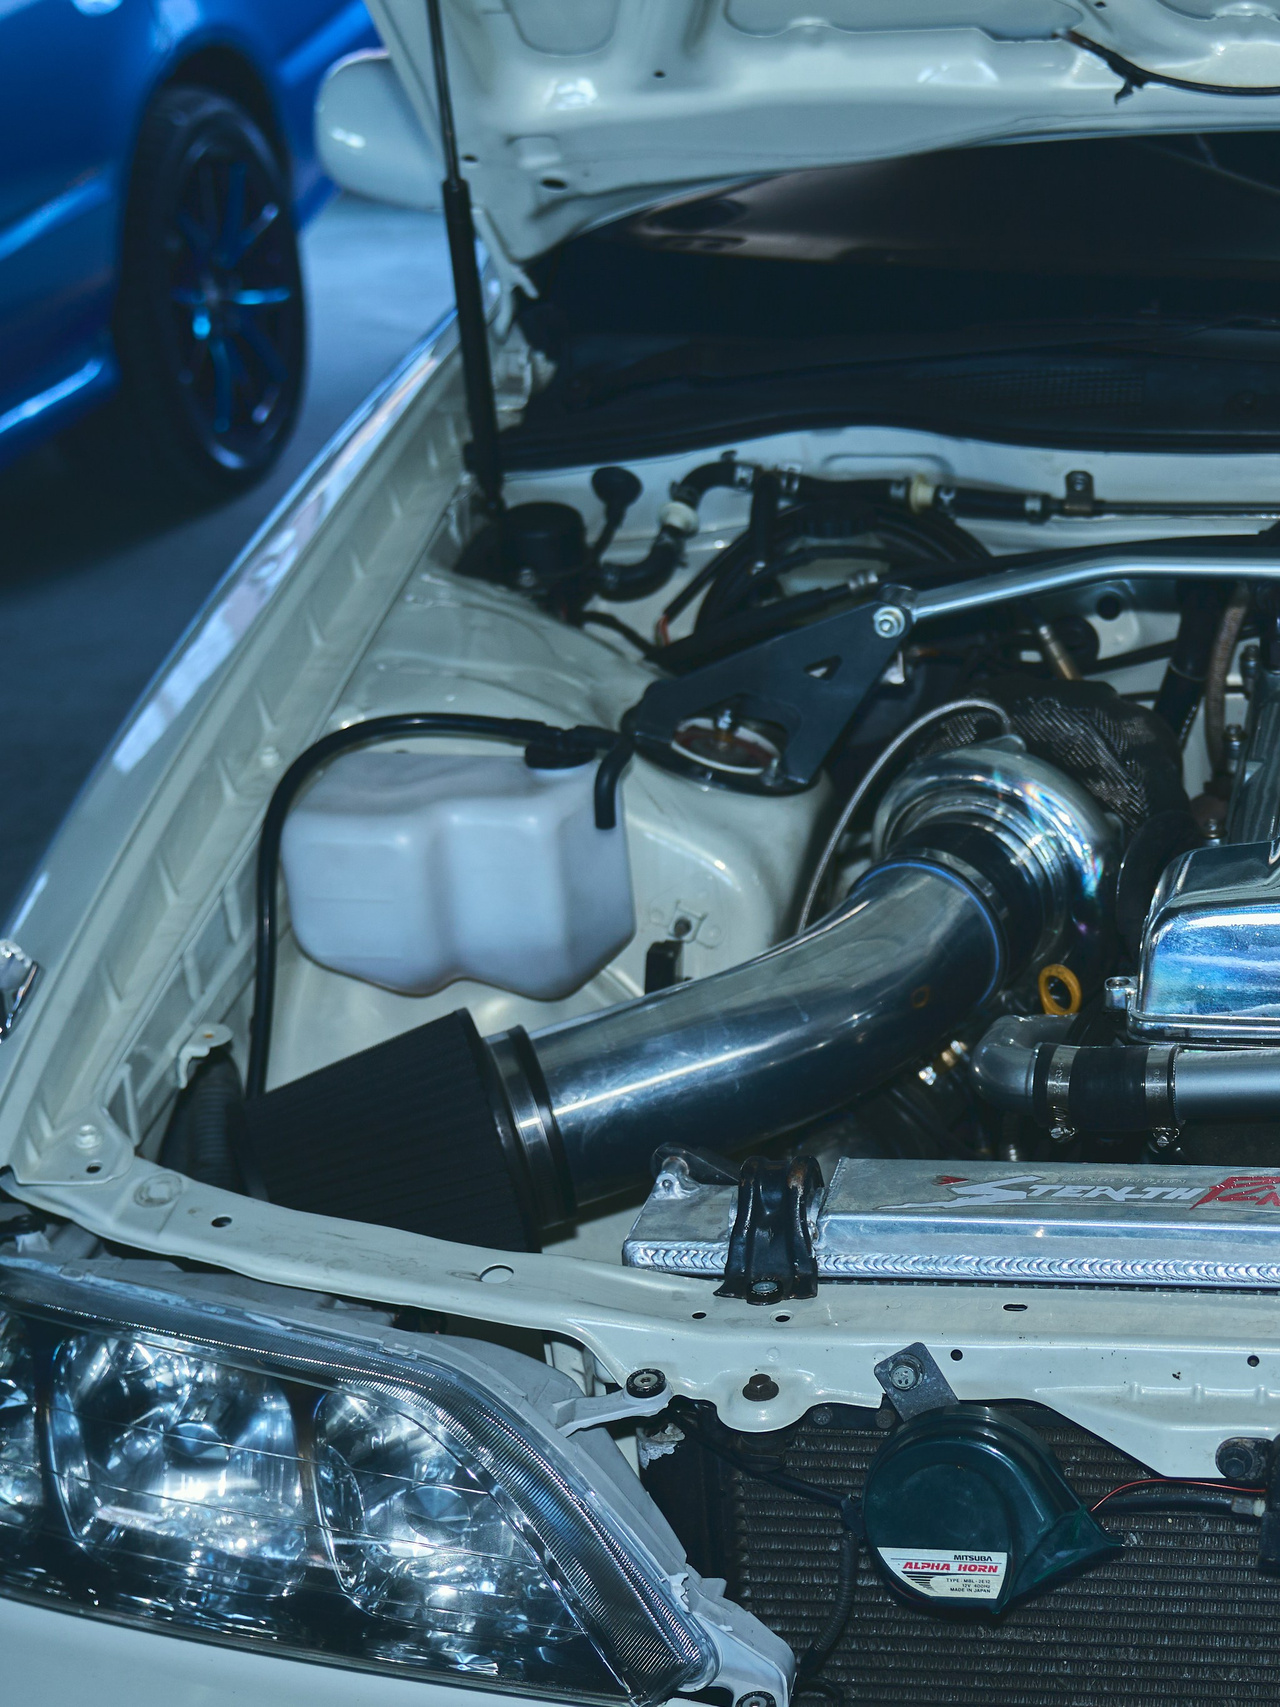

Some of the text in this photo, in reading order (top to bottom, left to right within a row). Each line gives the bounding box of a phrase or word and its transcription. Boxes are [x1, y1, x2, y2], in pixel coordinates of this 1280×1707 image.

[953, 1554, 993, 1562] MITSUBA
[902, 1561, 999, 1573] ALPHA HORN
